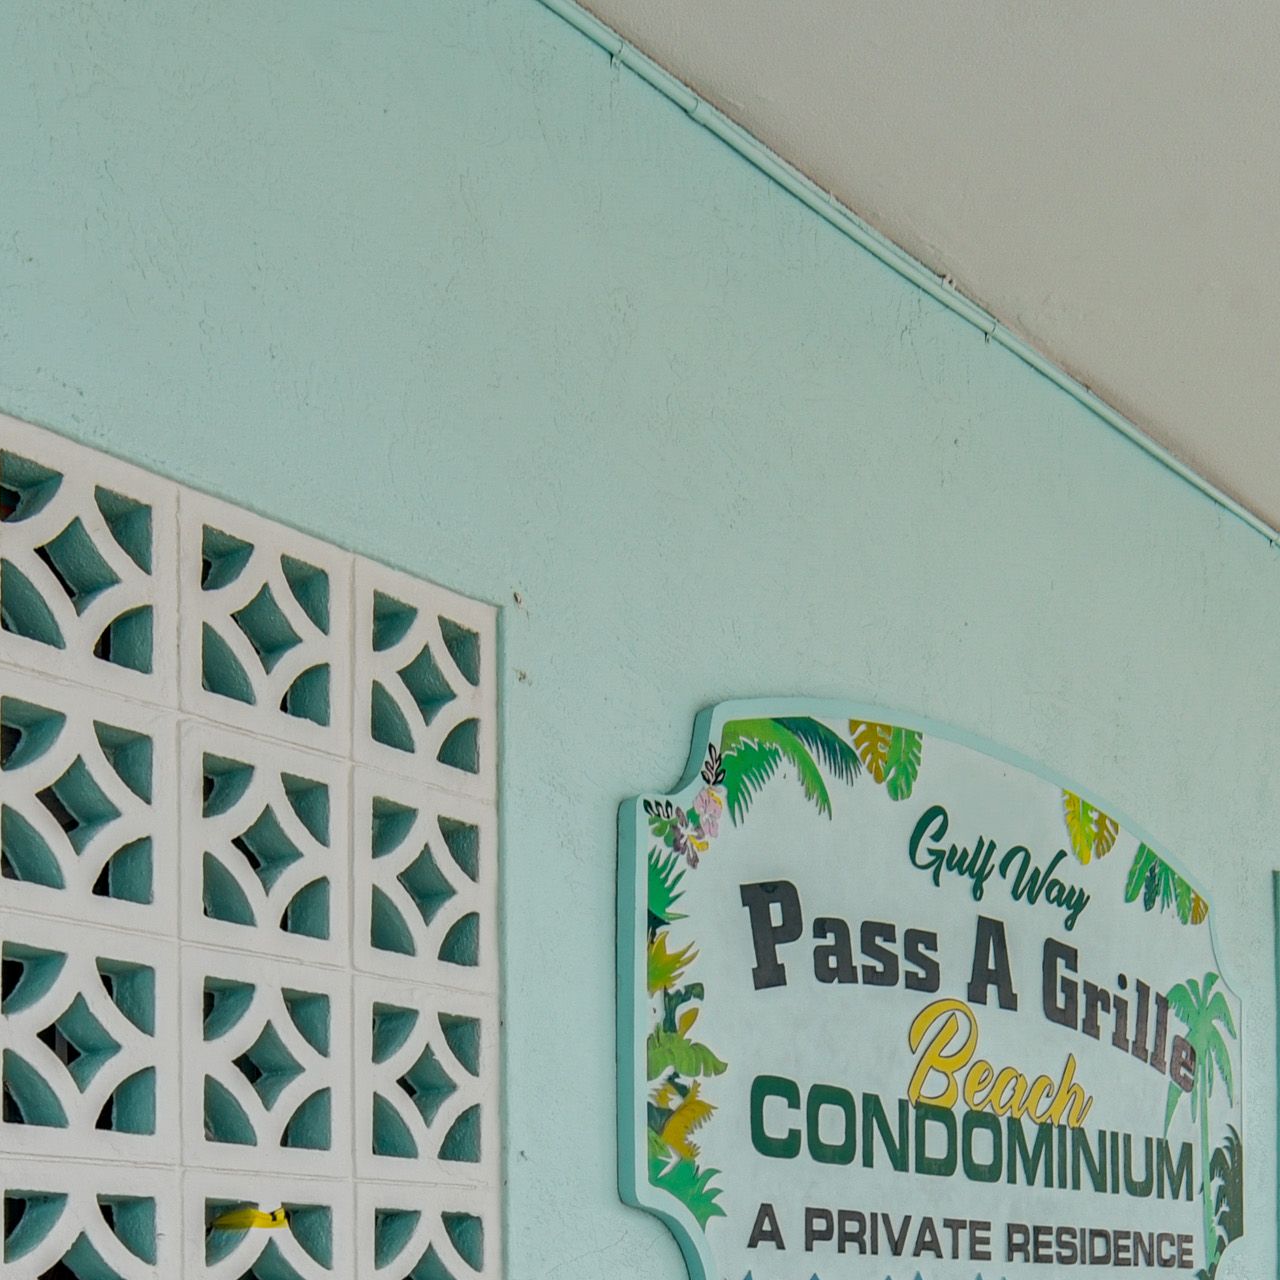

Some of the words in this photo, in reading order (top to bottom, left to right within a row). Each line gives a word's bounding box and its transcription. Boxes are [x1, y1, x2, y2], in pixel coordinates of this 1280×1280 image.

[909, 805, 997, 901] Gulf
[999, 847, 1090, 931] Way
[739, 880, 940, 994] Pass
[967, 914, 1018, 1011] A
[1042, 937, 1196, 1093] Grille
[907, 998, 1093, 1129] Beach
[750, 1075, 1194, 1202] CONDOMINIUM
[747, 1203, 786, 1251] A
[804, 1207, 992, 1262] PRIVATE
[1007, 1223, 1194, 1269] RESIDENCE
